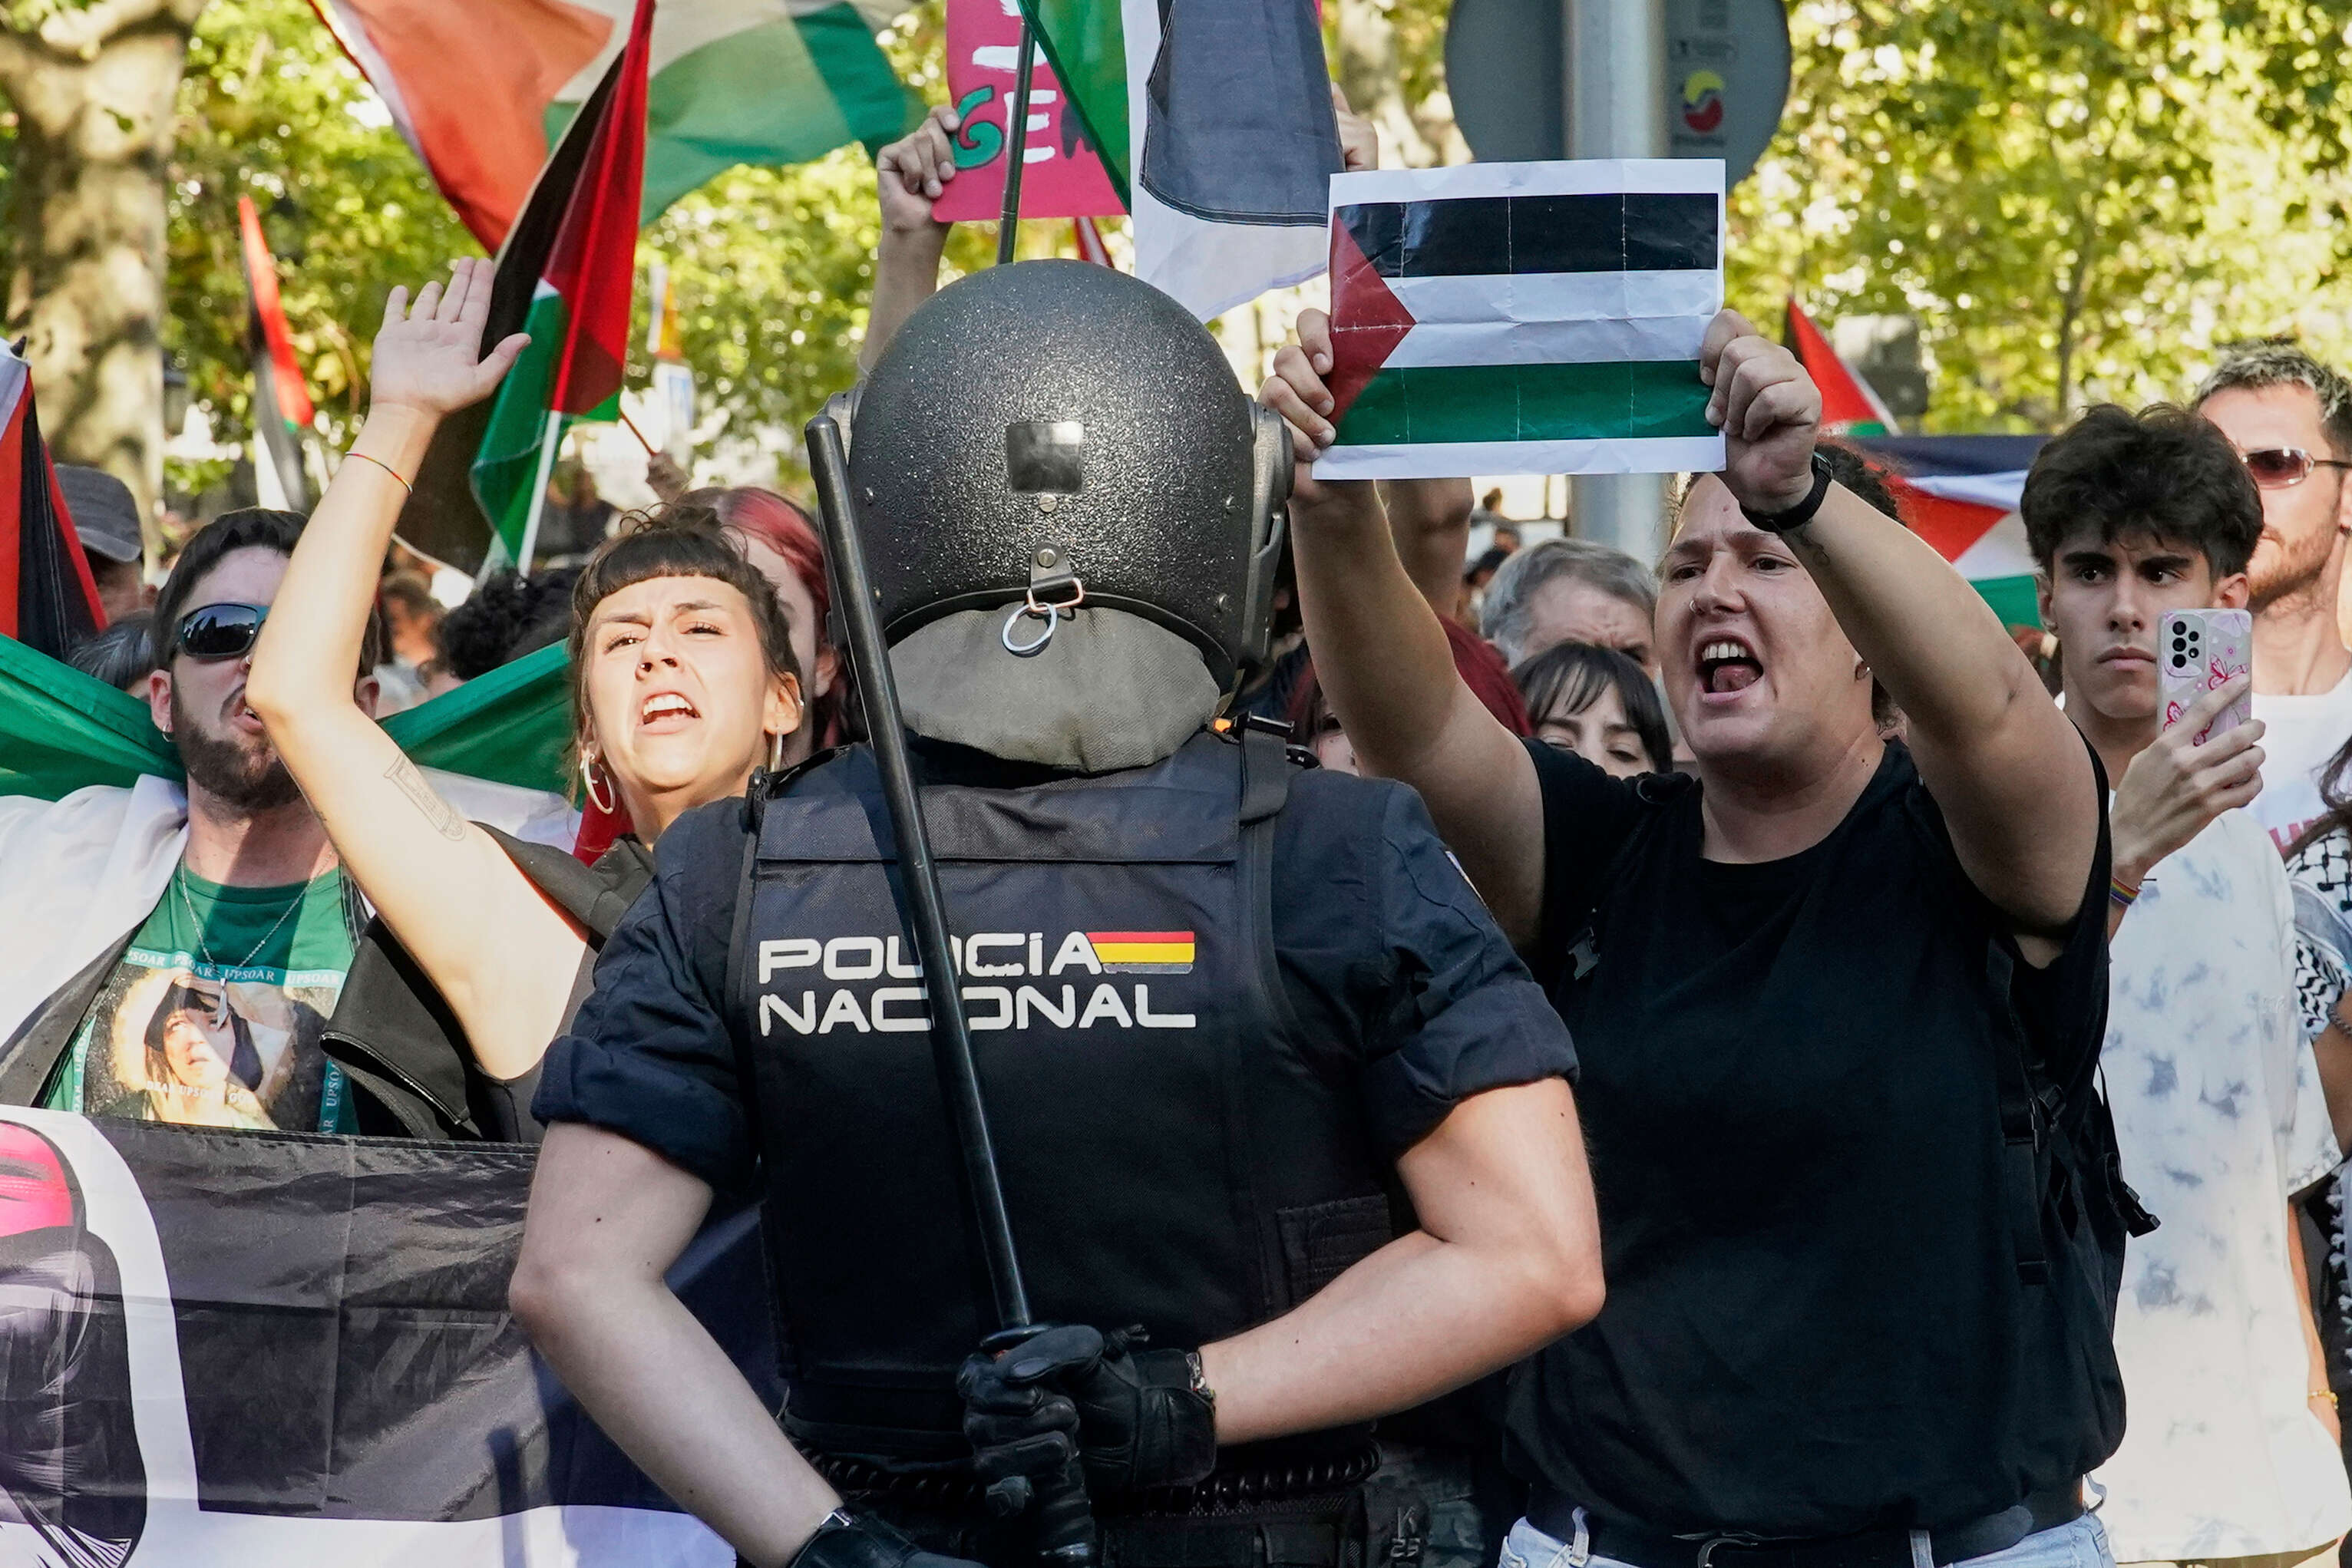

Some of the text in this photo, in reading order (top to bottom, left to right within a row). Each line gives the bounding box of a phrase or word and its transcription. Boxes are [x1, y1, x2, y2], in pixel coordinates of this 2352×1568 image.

[224, 969, 274, 982] UPSOAR
[286, 974, 339, 984] UPSOAR
[758, 983, 1197, 1036] NACONAL
